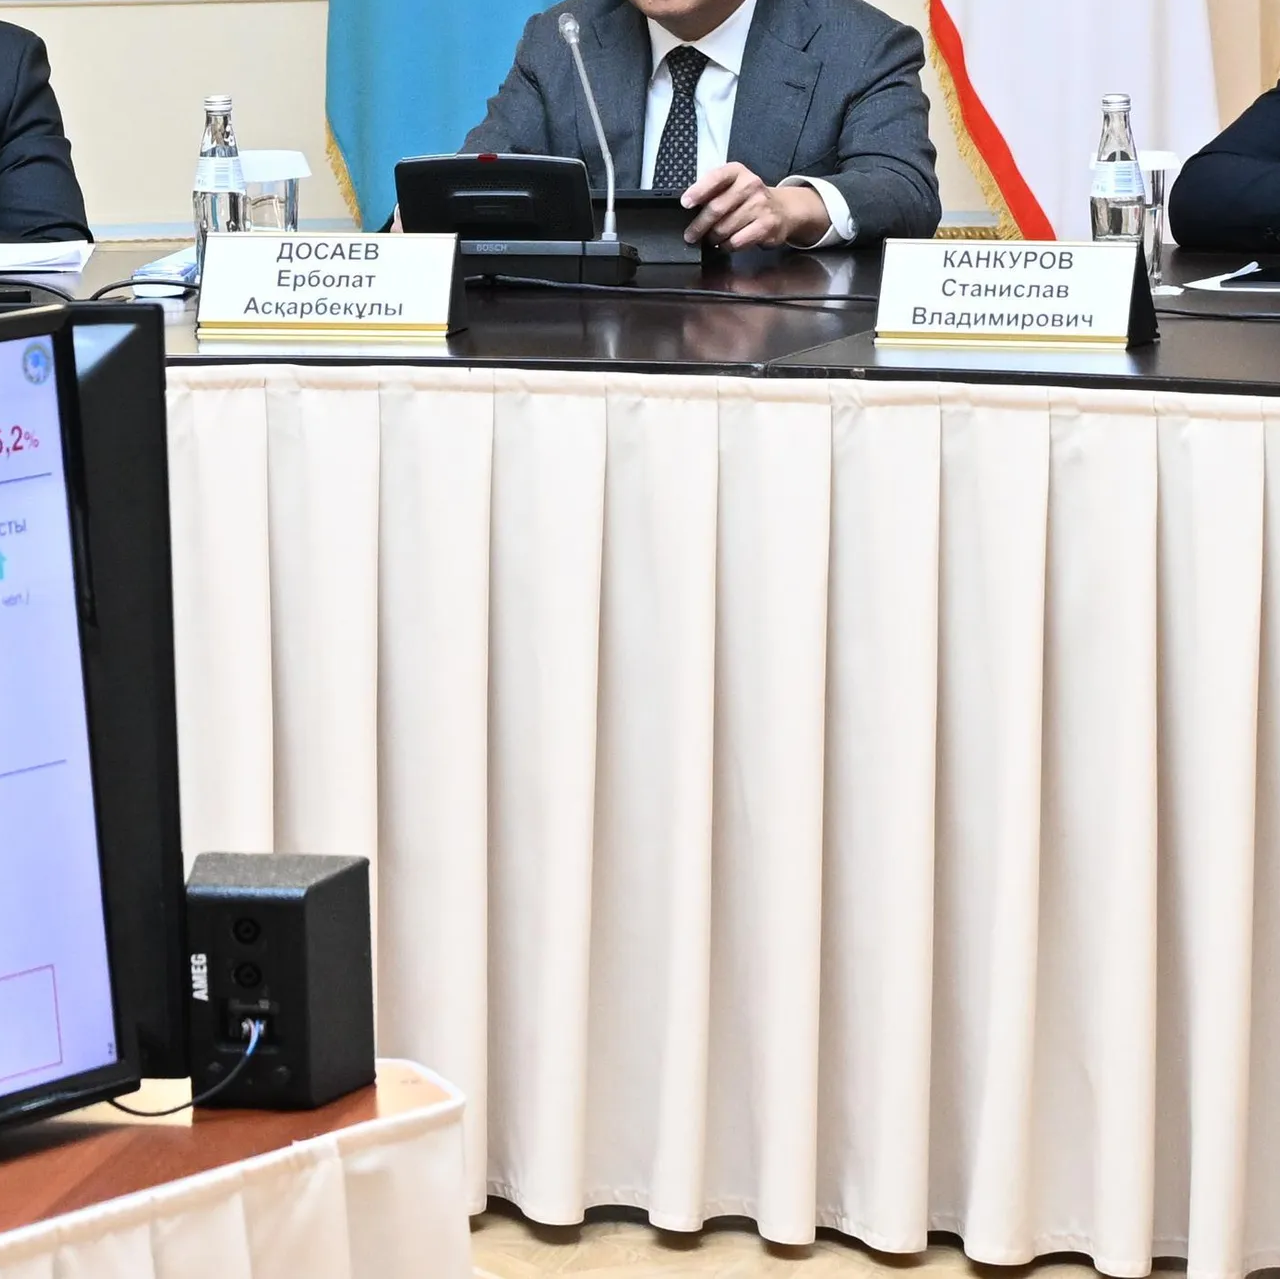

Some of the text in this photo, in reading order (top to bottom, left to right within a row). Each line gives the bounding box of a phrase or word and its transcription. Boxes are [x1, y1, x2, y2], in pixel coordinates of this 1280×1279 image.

[277, 242, 379, 263] ДОСАЕВ
[476, 244, 508, 252] BOSCH
[943, 250, 1073, 270] КАНКУРОВ
[277, 270, 376, 291] Ерболат
[942, 278, 1069, 299] Станислав
[244, 296, 403, 319] Асқарбекұлы
[912, 307, 1093, 330] Владимирович
[190, 953, 209, 1001] AMEG
